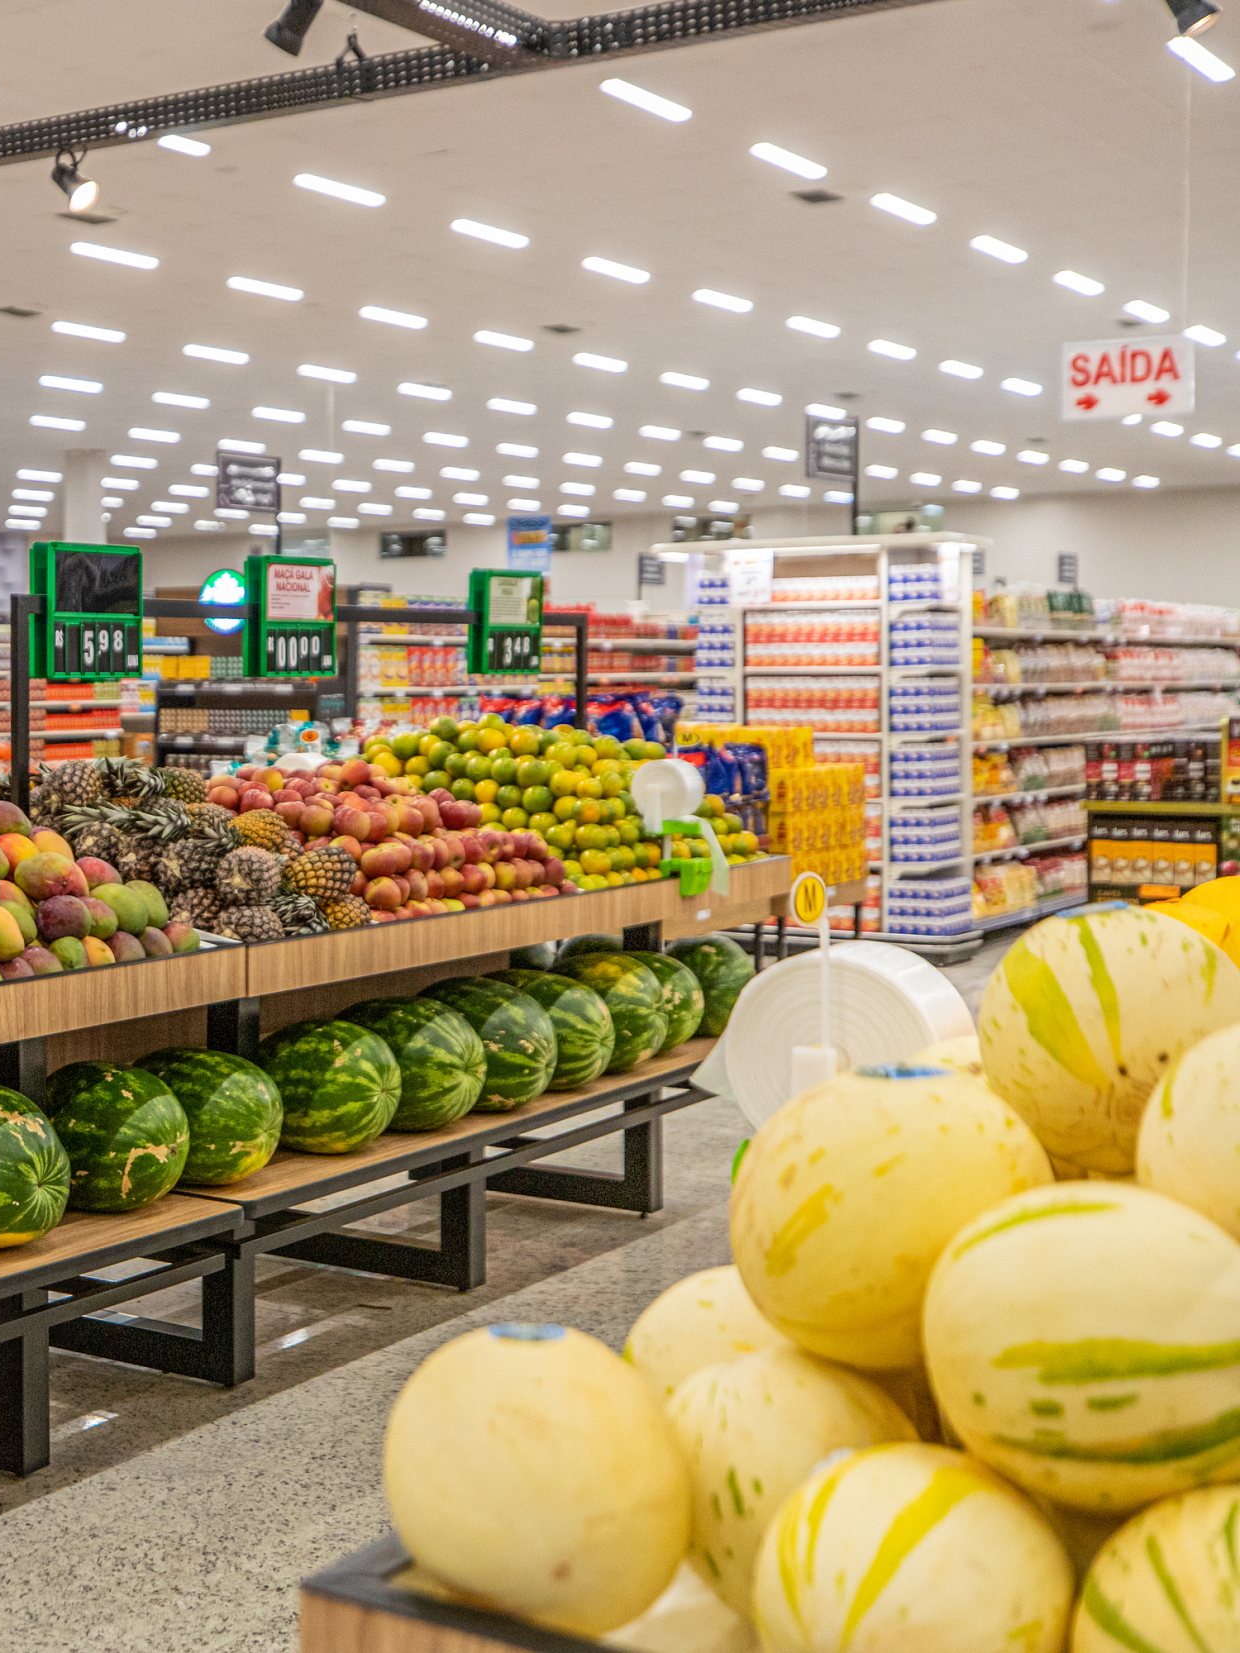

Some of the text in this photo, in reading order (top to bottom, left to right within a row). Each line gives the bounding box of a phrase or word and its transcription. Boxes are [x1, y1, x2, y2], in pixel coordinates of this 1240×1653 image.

[1070, 344, 1180, 387] SAÍDA
[276, 581, 311, 592] NACIONAL
[682, 733, 693, 743] M
[804, 884, 816, 912] M
